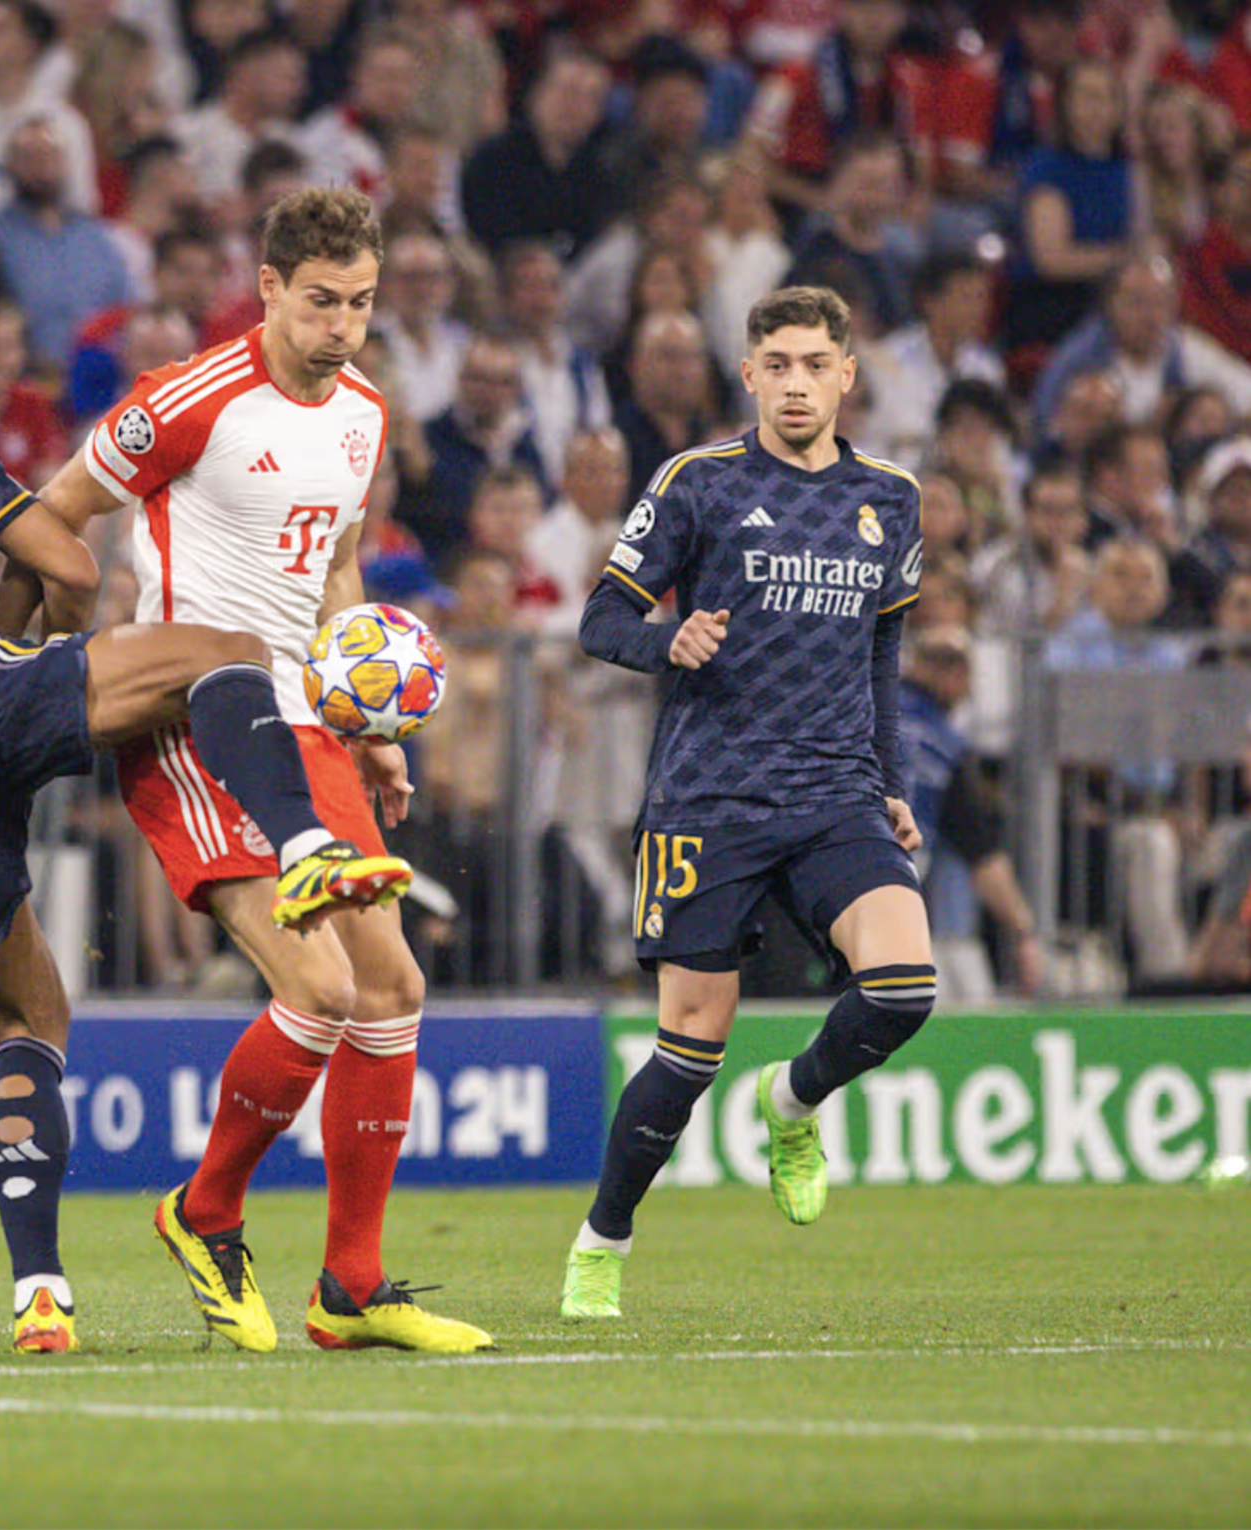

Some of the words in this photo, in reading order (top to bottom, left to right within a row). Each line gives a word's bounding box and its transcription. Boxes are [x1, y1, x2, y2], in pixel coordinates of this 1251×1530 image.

[278, 505, 339, 575] T
[743, 550, 886, 590] Emirates
[761, 584, 799, 613] FLY
[800, 586, 865, 620] BETTER
[652, 832, 703, 899] 15
[357, 1120, 379, 1133] FC
